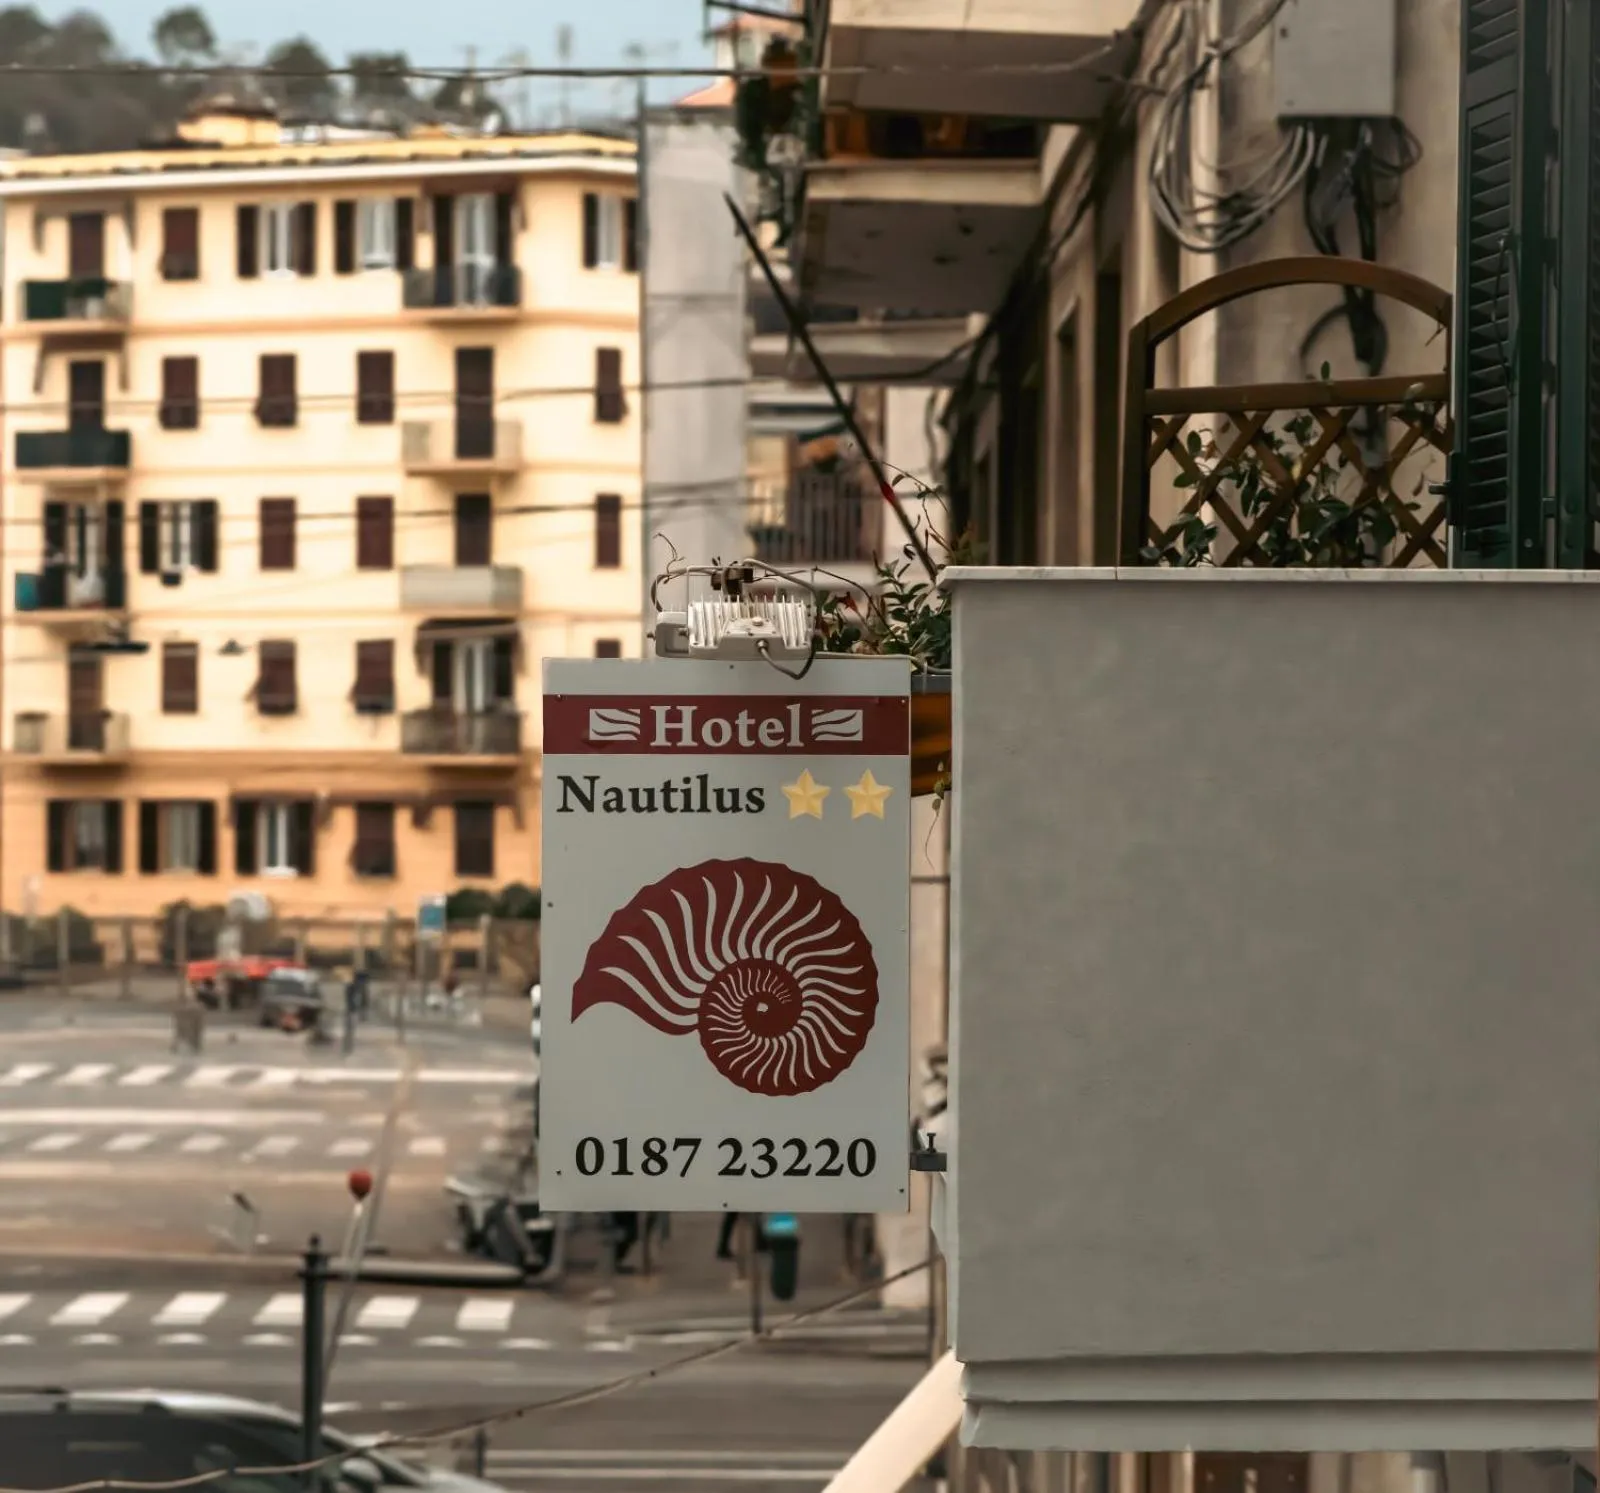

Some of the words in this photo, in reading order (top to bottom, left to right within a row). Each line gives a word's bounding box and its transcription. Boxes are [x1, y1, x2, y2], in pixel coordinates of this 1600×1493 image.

[649, 703, 806, 749] Hotel
[556, 773, 766, 814] Nautilus
[575, 1136, 702, 1177] 0187
[717, 1137, 878, 1178] 23220
